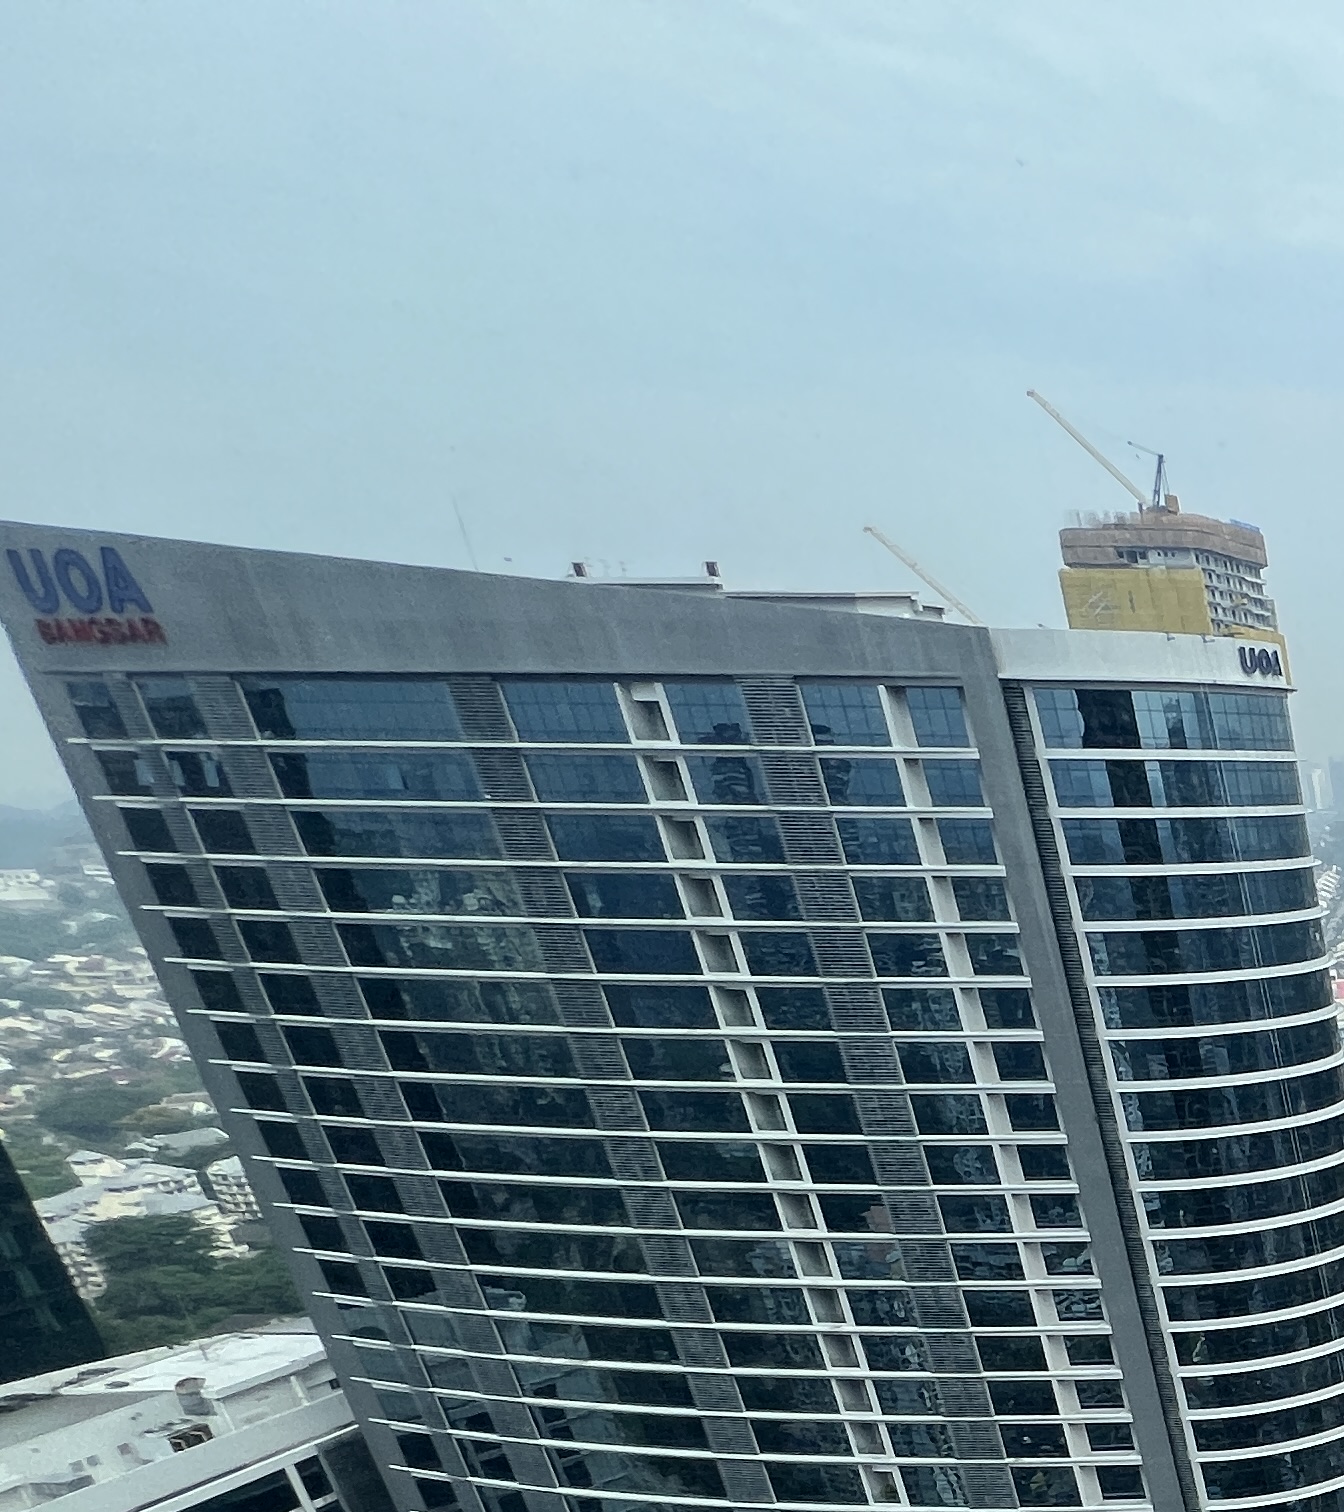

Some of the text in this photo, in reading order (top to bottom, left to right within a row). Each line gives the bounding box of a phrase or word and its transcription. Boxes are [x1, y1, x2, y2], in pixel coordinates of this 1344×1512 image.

[6, 545, 154, 615] UOA
[34, 617, 168, 647] BANGSAR
[1237, 646, 1284, 678] UOA
